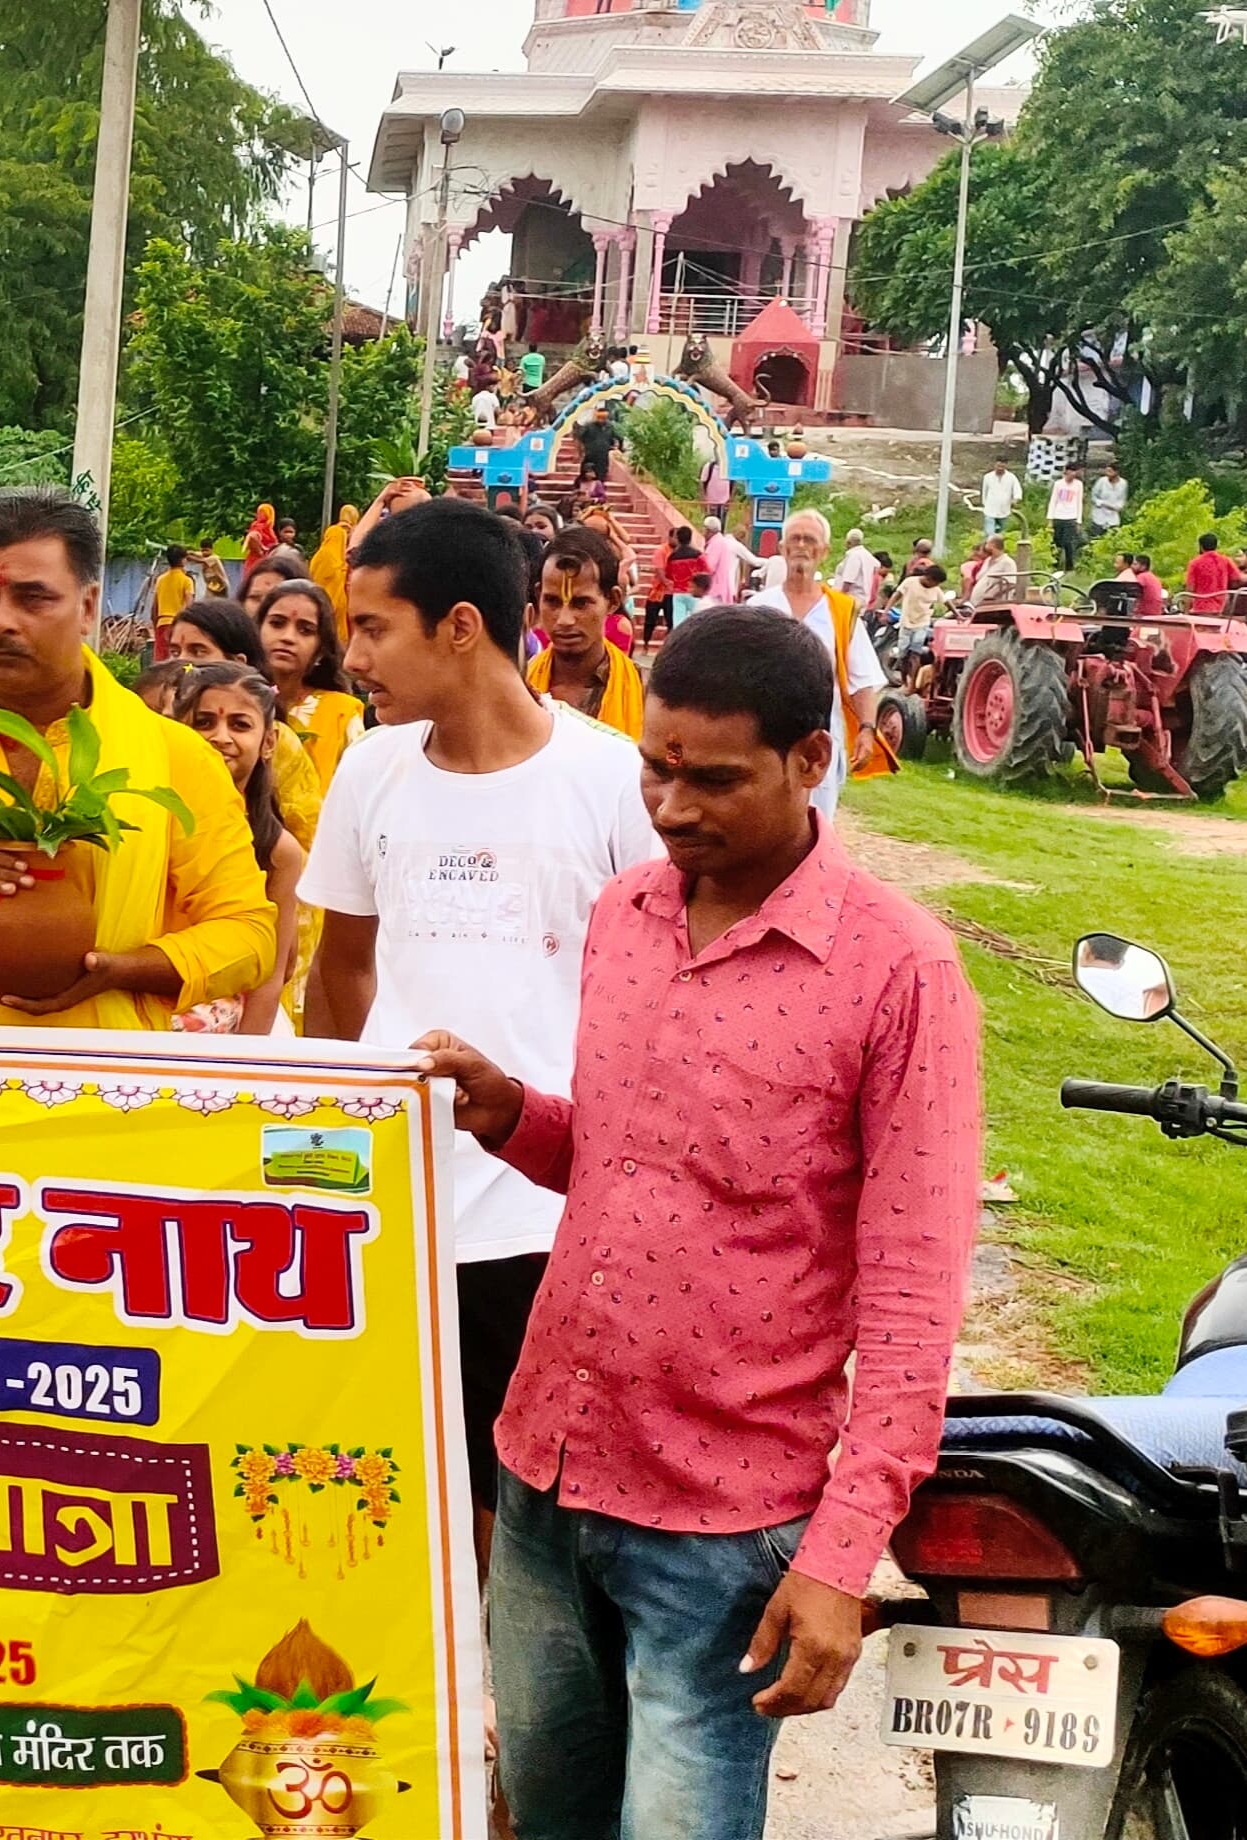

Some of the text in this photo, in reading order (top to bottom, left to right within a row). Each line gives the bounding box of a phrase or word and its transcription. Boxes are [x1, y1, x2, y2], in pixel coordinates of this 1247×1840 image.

[428, 869, 499, 882] ENCAVED
[438, 855, 477, 868] DECO
[40, 1185, 370, 1331] नाथ
[936, 1637, 1060, 1695] प्रेस
[891, 1696, 994, 1740] BR07R
[10, 1718, 96, 1772] मंदिर
[102, 1733, 167, 1769] तक
